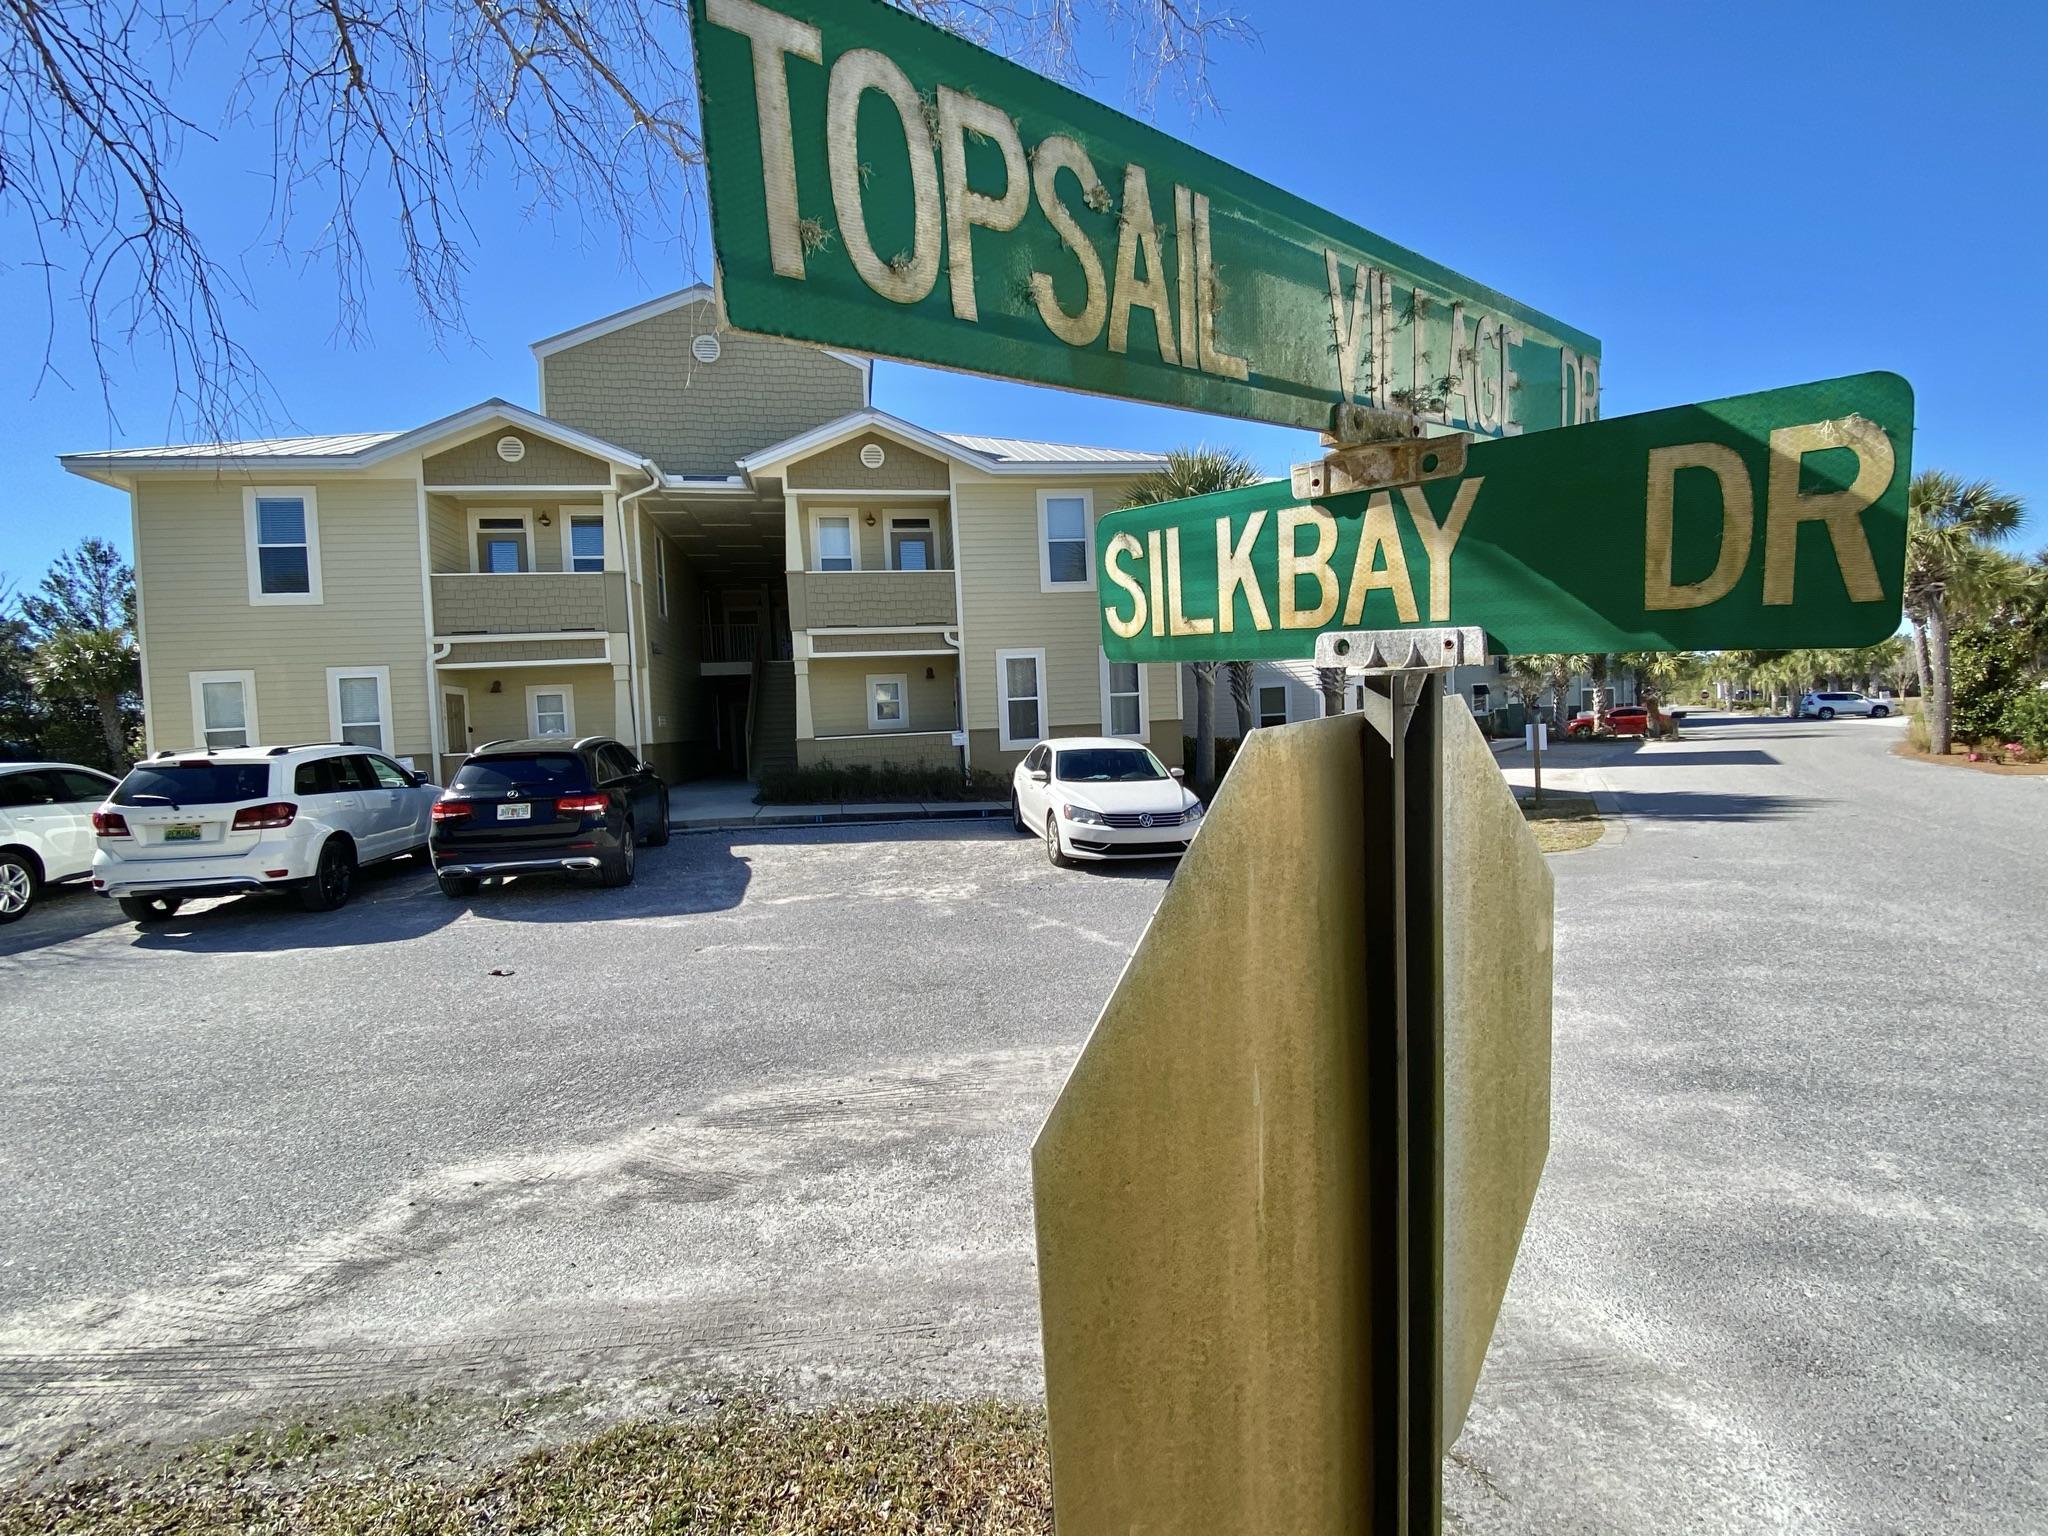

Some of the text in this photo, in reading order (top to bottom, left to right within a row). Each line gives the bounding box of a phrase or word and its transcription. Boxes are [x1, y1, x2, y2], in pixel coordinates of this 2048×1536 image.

[706, 0, 1598, 437] TOPSAIL VILLAGE DR
[1105, 413, 1895, 638] SILKBAY DR
